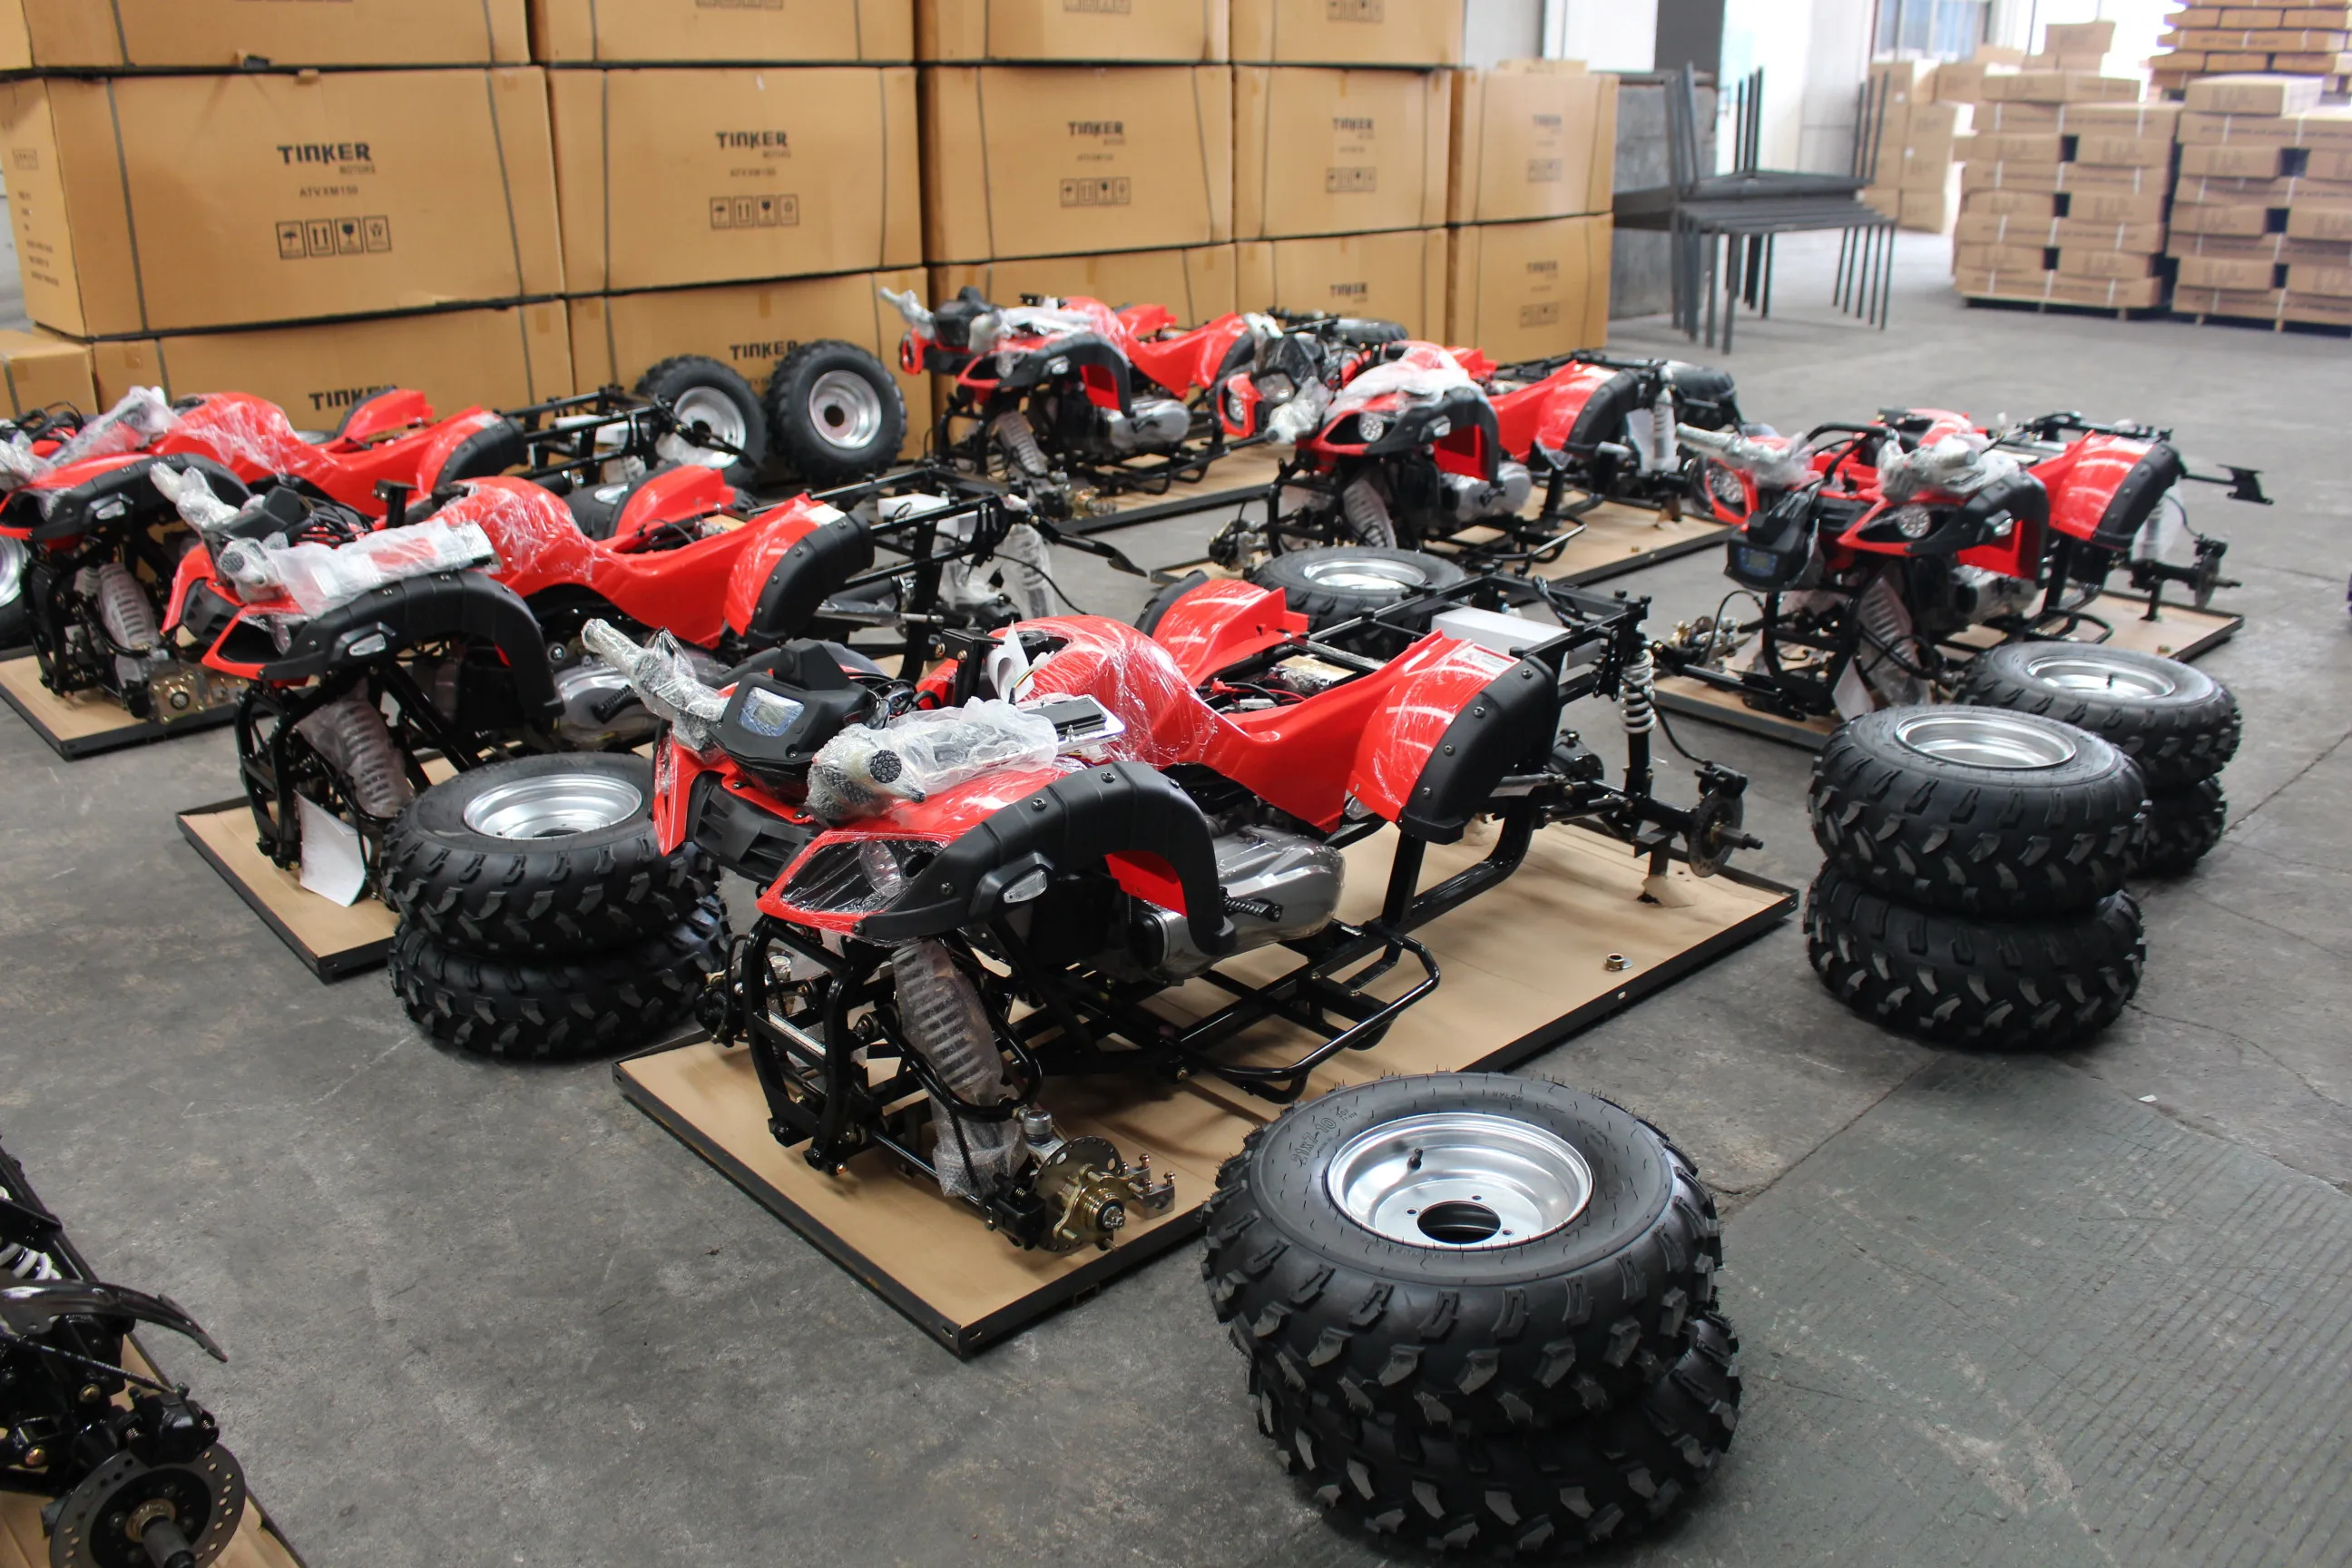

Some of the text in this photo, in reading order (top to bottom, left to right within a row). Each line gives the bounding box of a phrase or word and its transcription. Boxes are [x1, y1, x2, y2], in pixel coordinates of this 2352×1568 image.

[1067, 121, 1124, 137] TINKER
[715, 131, 788, 150] TINKER
[277, 142, 371, 164] TINKER
